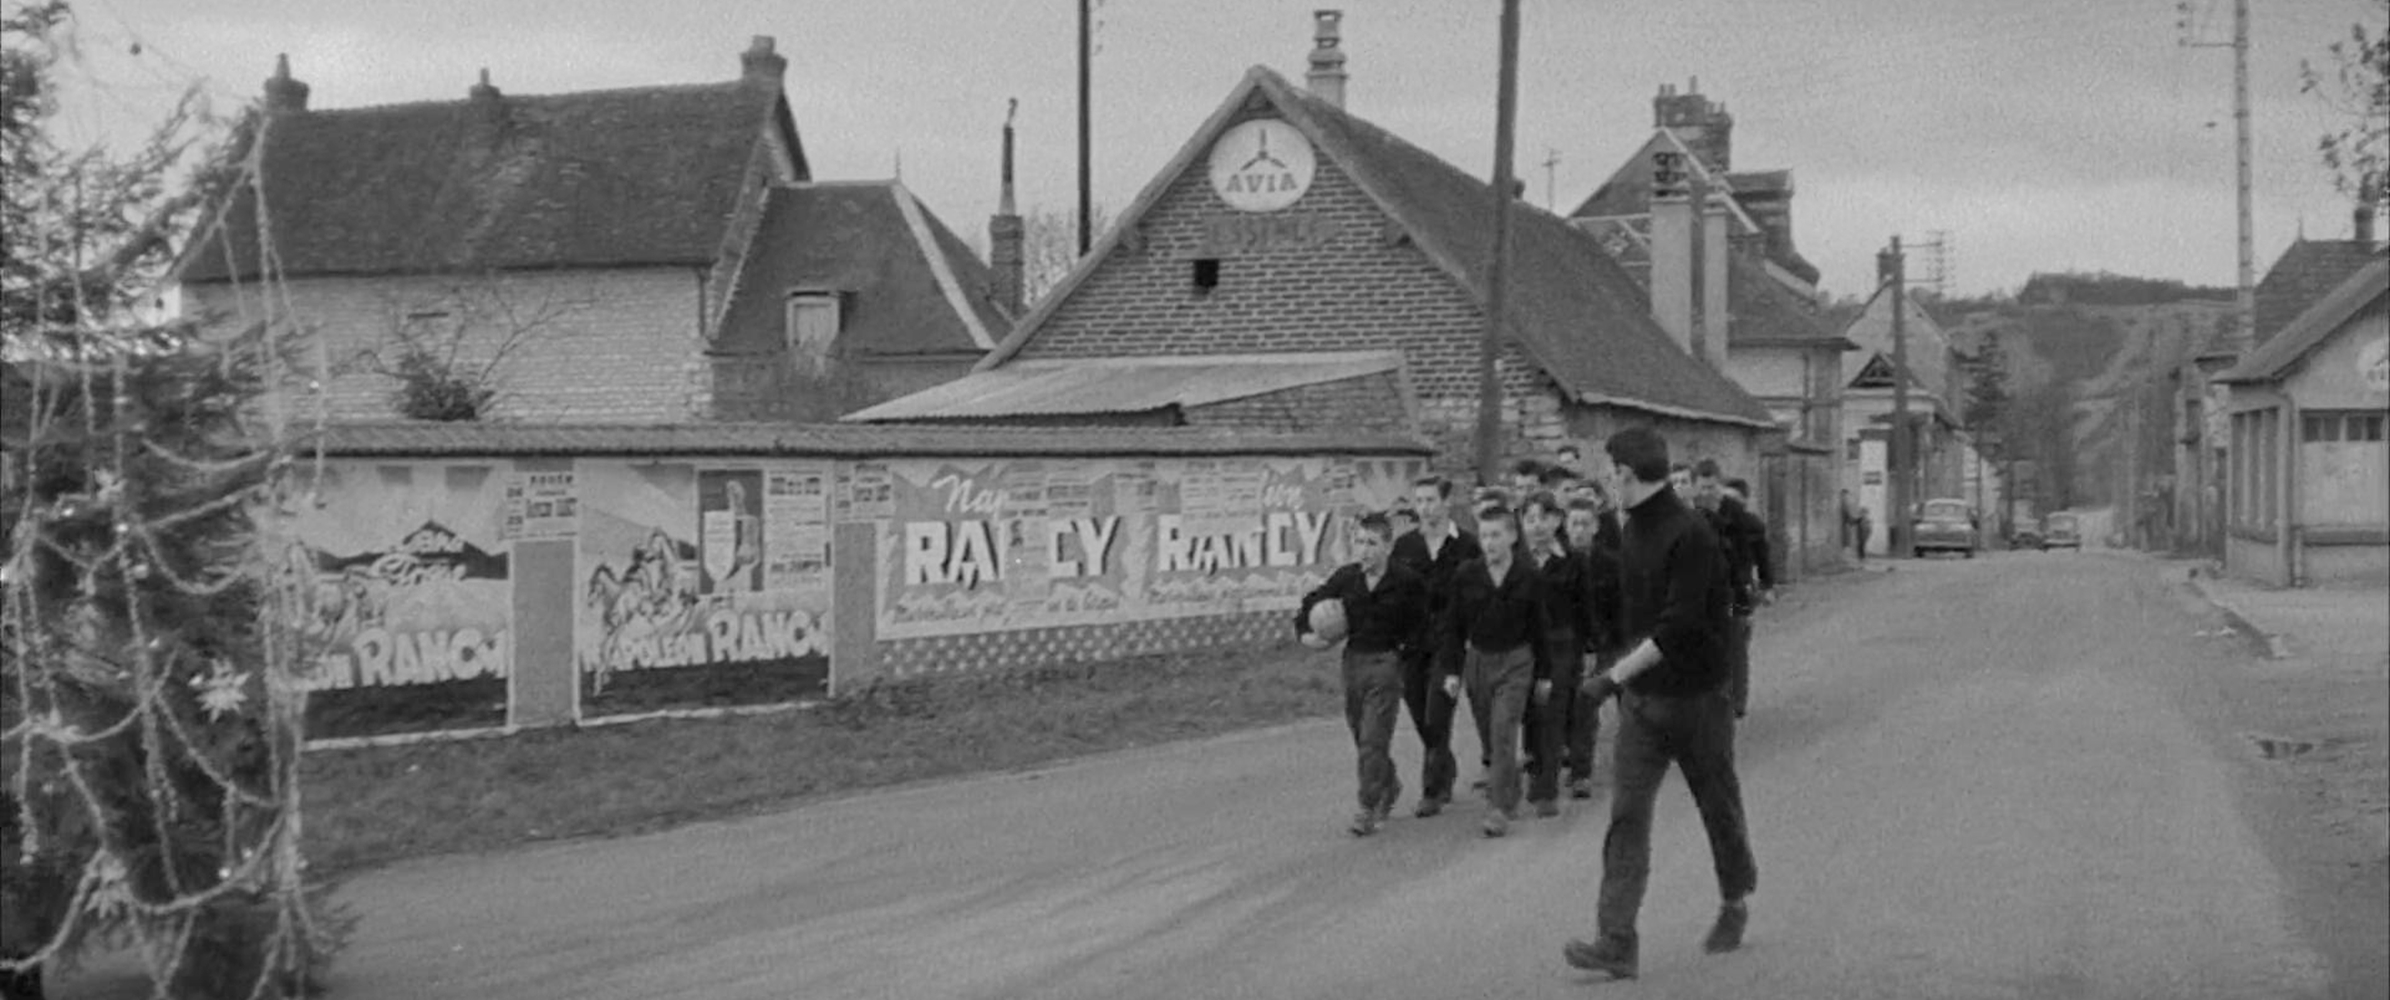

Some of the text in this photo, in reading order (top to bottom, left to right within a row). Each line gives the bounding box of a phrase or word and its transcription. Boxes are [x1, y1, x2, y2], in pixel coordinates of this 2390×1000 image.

[1225, 173, 1298, 193] AVIA
[905, 516, 1121, 590] RACY
[1158, 510, 1333, 577] RANCY
